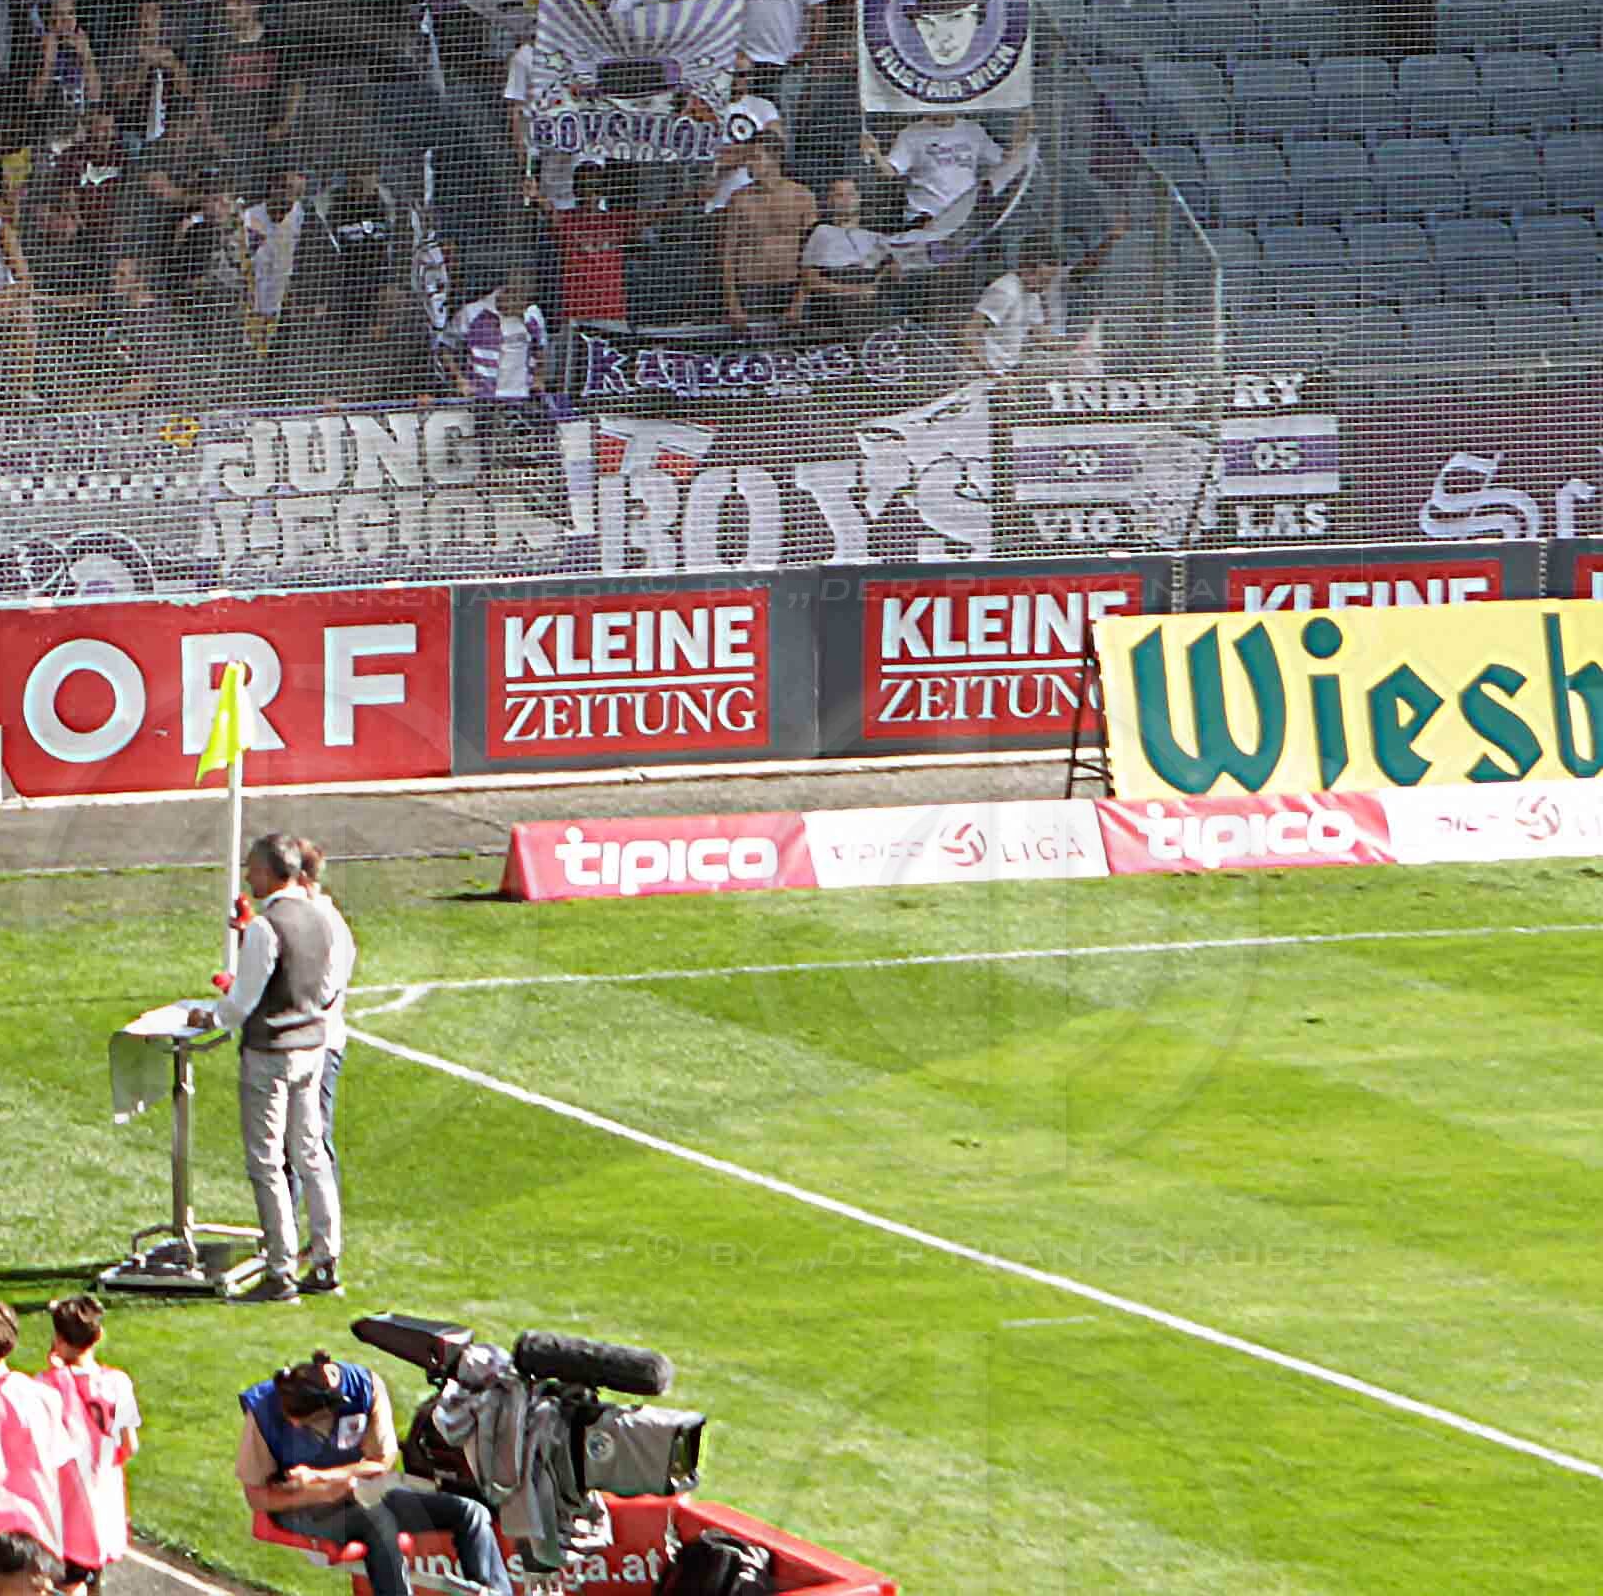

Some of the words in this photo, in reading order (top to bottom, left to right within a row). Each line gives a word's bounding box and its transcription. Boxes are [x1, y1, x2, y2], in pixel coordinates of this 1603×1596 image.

[1251, 441, 1302, 472] 05
[504, 606, 754, 679] KLEINE
[22, 623, 417, 765] ORF
[504, 687, 757, 743] ZEITUNG
[554, 825, 778, 895] tipico
[1145, 805, 1357, 870] tipico
